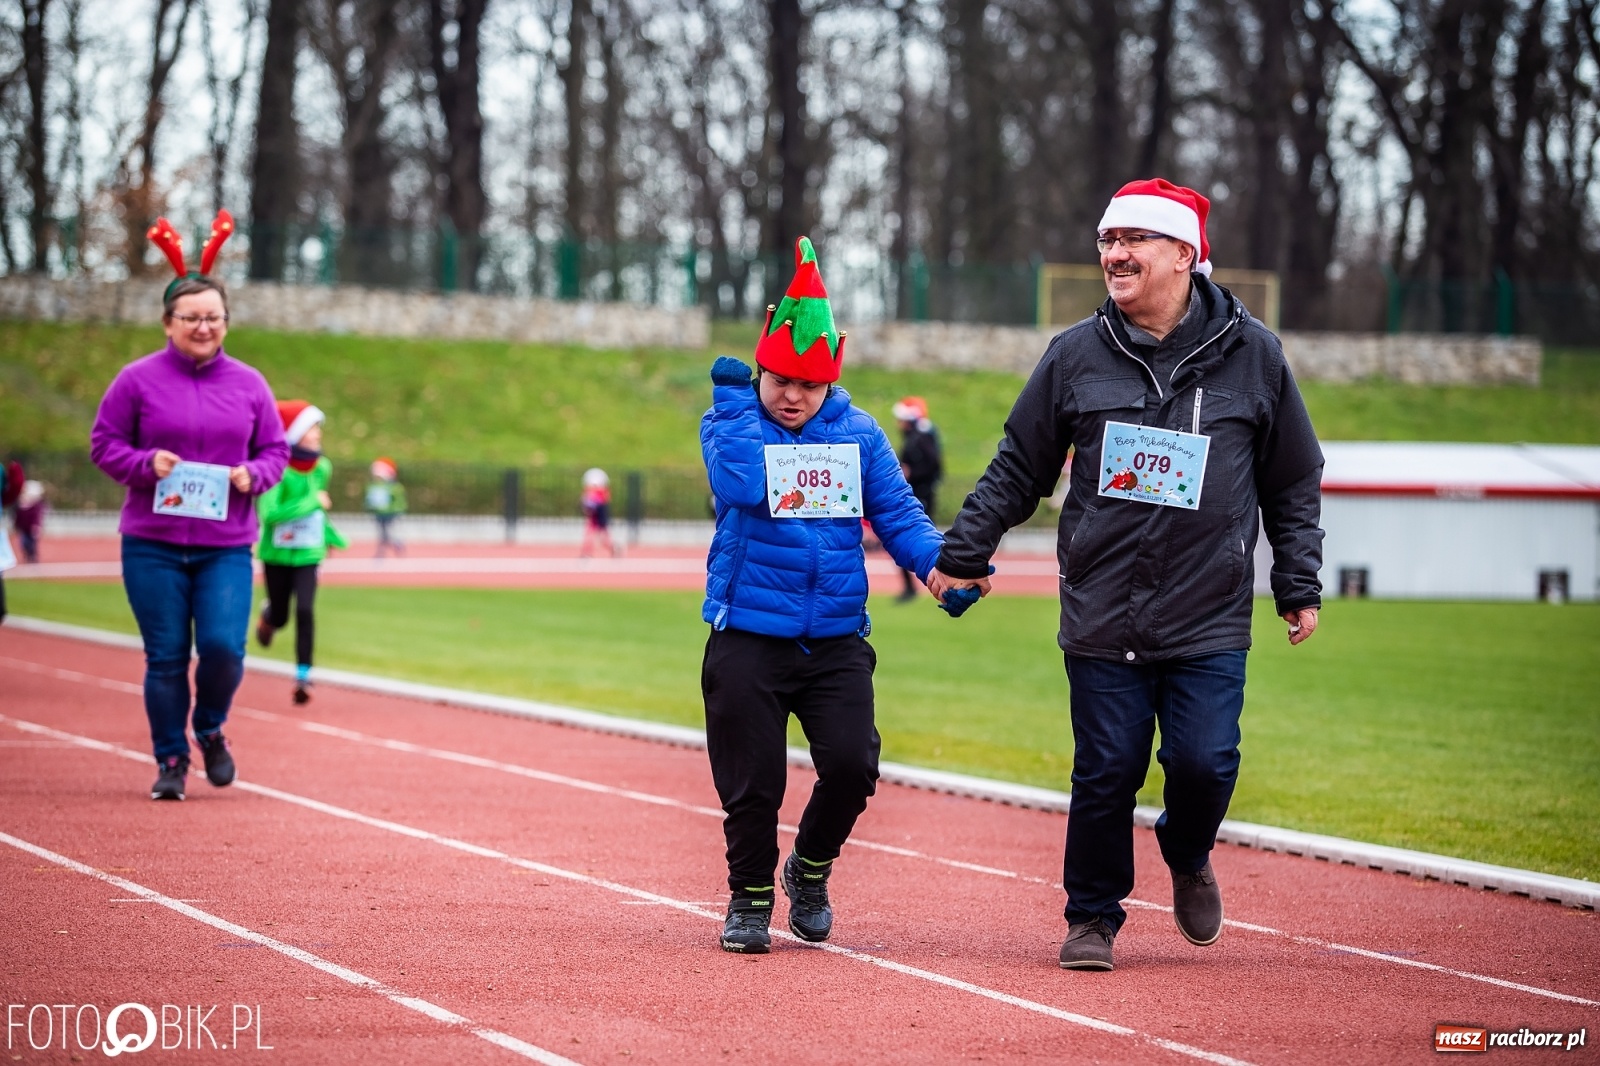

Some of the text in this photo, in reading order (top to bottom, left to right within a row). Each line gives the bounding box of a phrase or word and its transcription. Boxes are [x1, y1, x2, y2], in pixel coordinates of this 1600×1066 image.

[1133, 451, 1171, 474] 079
[182, 480, 205, 496] 107
[797, 469, 832, 488] 083
